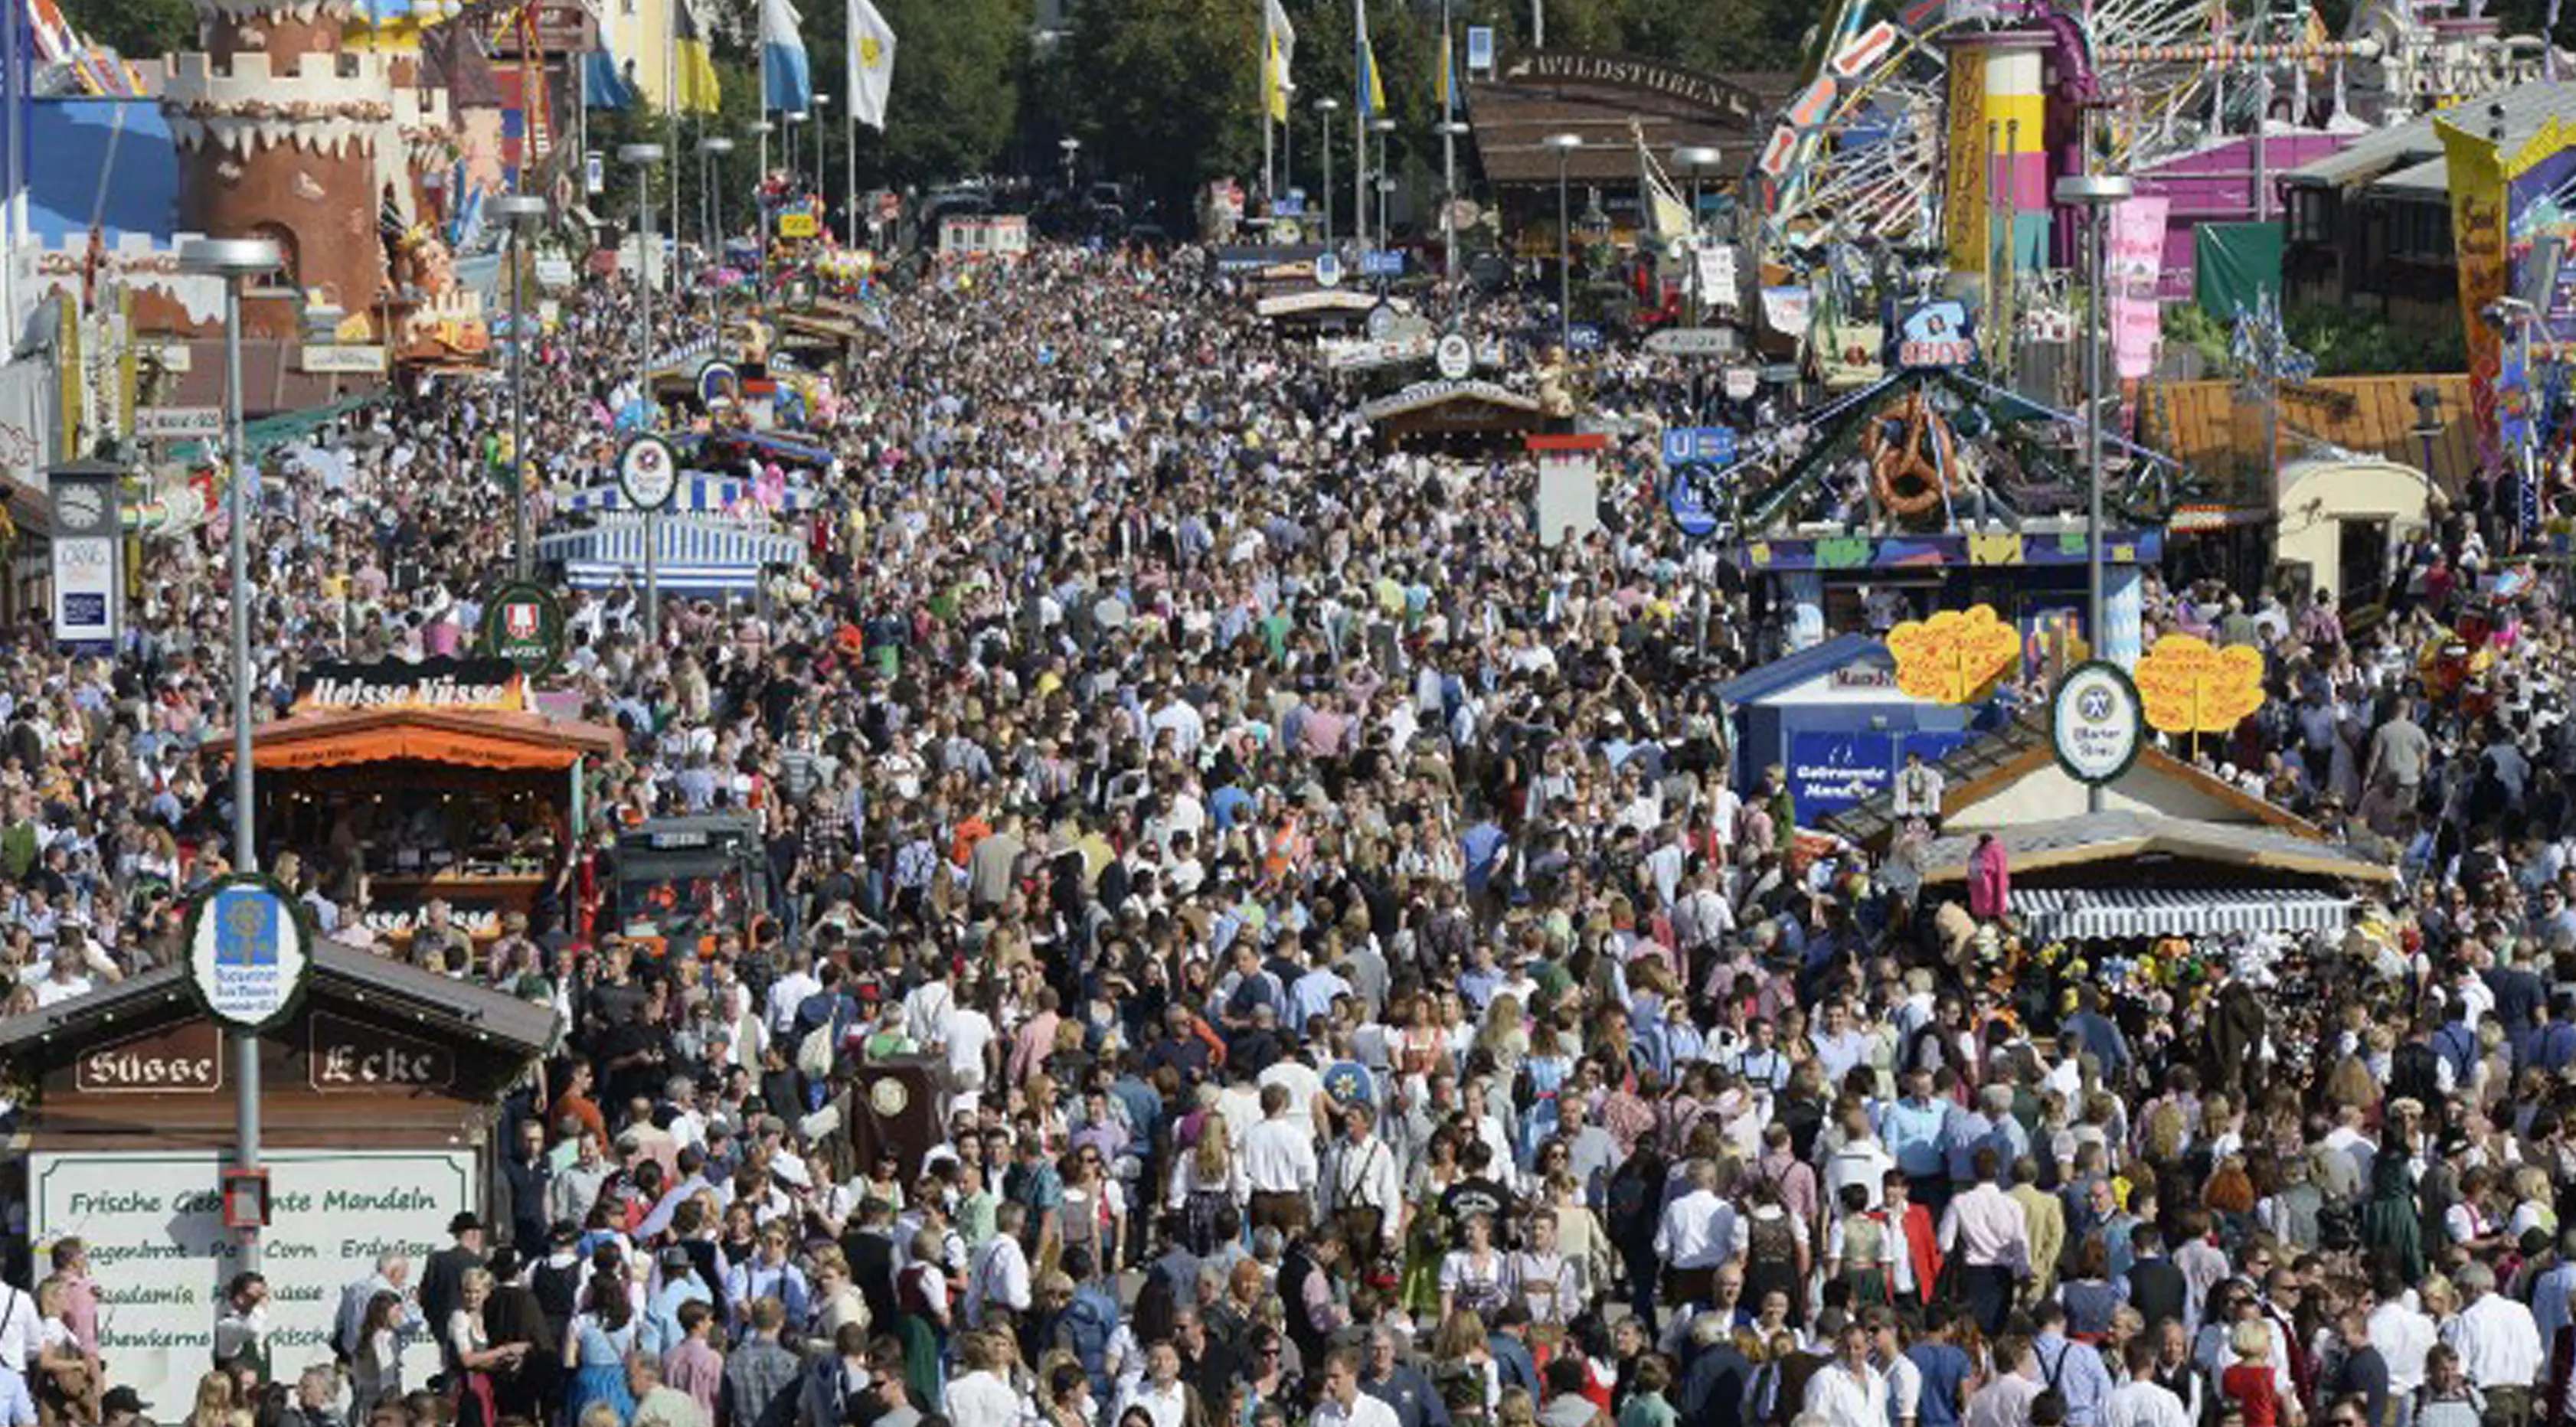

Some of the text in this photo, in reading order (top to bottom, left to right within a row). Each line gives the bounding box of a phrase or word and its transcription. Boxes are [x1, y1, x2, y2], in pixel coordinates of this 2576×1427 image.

[1900, 340, 1970, 365] SHOP
[1671, 432, 1690, 457] U
[312, 673, 508, 705] Heisse Nüsse
[90, 1053, 212, 1082] Süsse
[321, 1043, 434, 1082] Ecke
[70, 1190, 162, 1213] Frische
[323, 1187, 436, 1212] Mandeln
